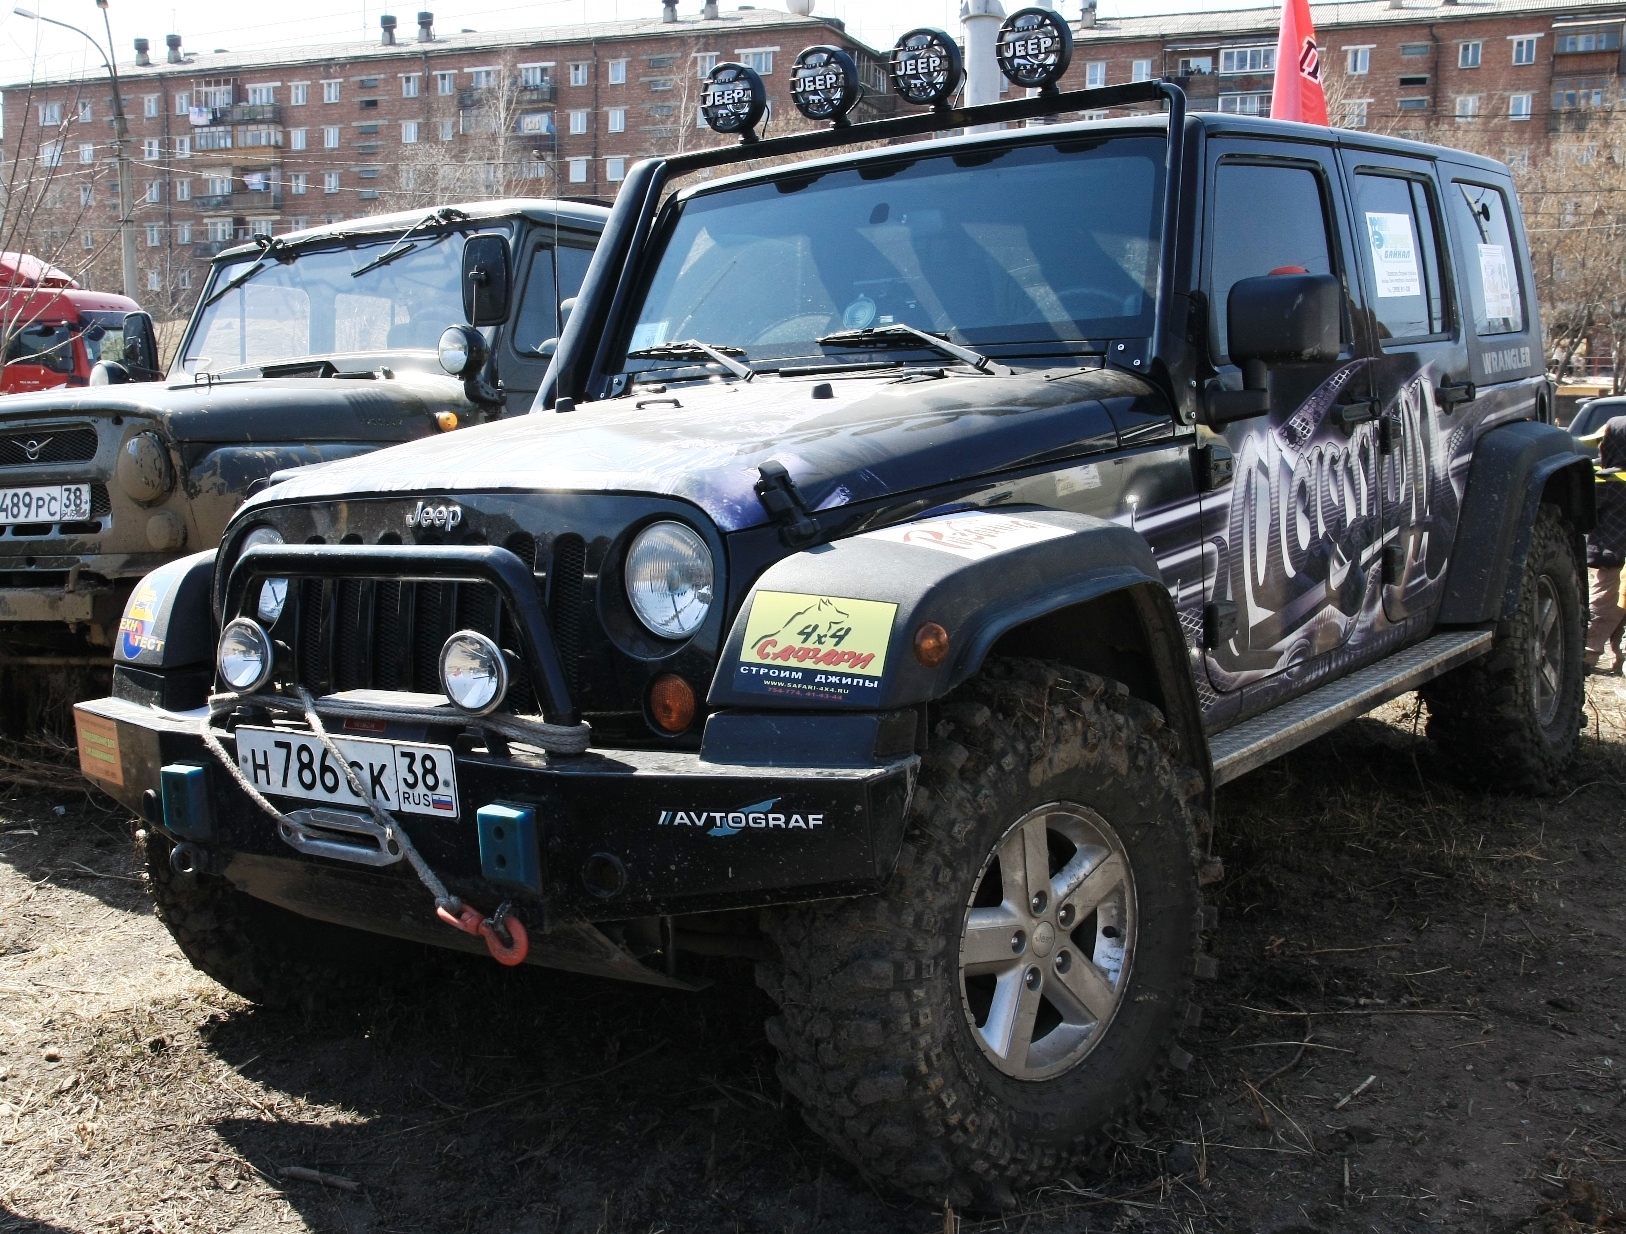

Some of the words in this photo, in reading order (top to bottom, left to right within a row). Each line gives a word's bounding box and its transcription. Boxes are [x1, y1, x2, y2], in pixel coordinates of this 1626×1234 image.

[1004, 38, 1053, 58] JEEP
[896, 57, 941, 75] JEEP
[796, 74, 837, 92] JEEP
[706, 89, 745, 106] JEEP
[1384, 249, 1411, 259] БАЙКАЛ
[1482, 346, 1532, 374] WRANGLER
[63, 486, 83, 509] 38
[405, 501, 462, 532] Jeep
[134, 634, 165, 652] ТЕСТ
[797, 624, 852, 647] 4x4
[756, 639, 876, 670] САФАРИ
[740, 666, 803, 680] СТРОИМ
[814, 674, 879, 688] ДЖИПЫ
[763, 679, 850, 694] WWW.SAFARI-4X4.RU
[400, 750, 440, 792] 38
[403, 791, 431, 807] RUS
